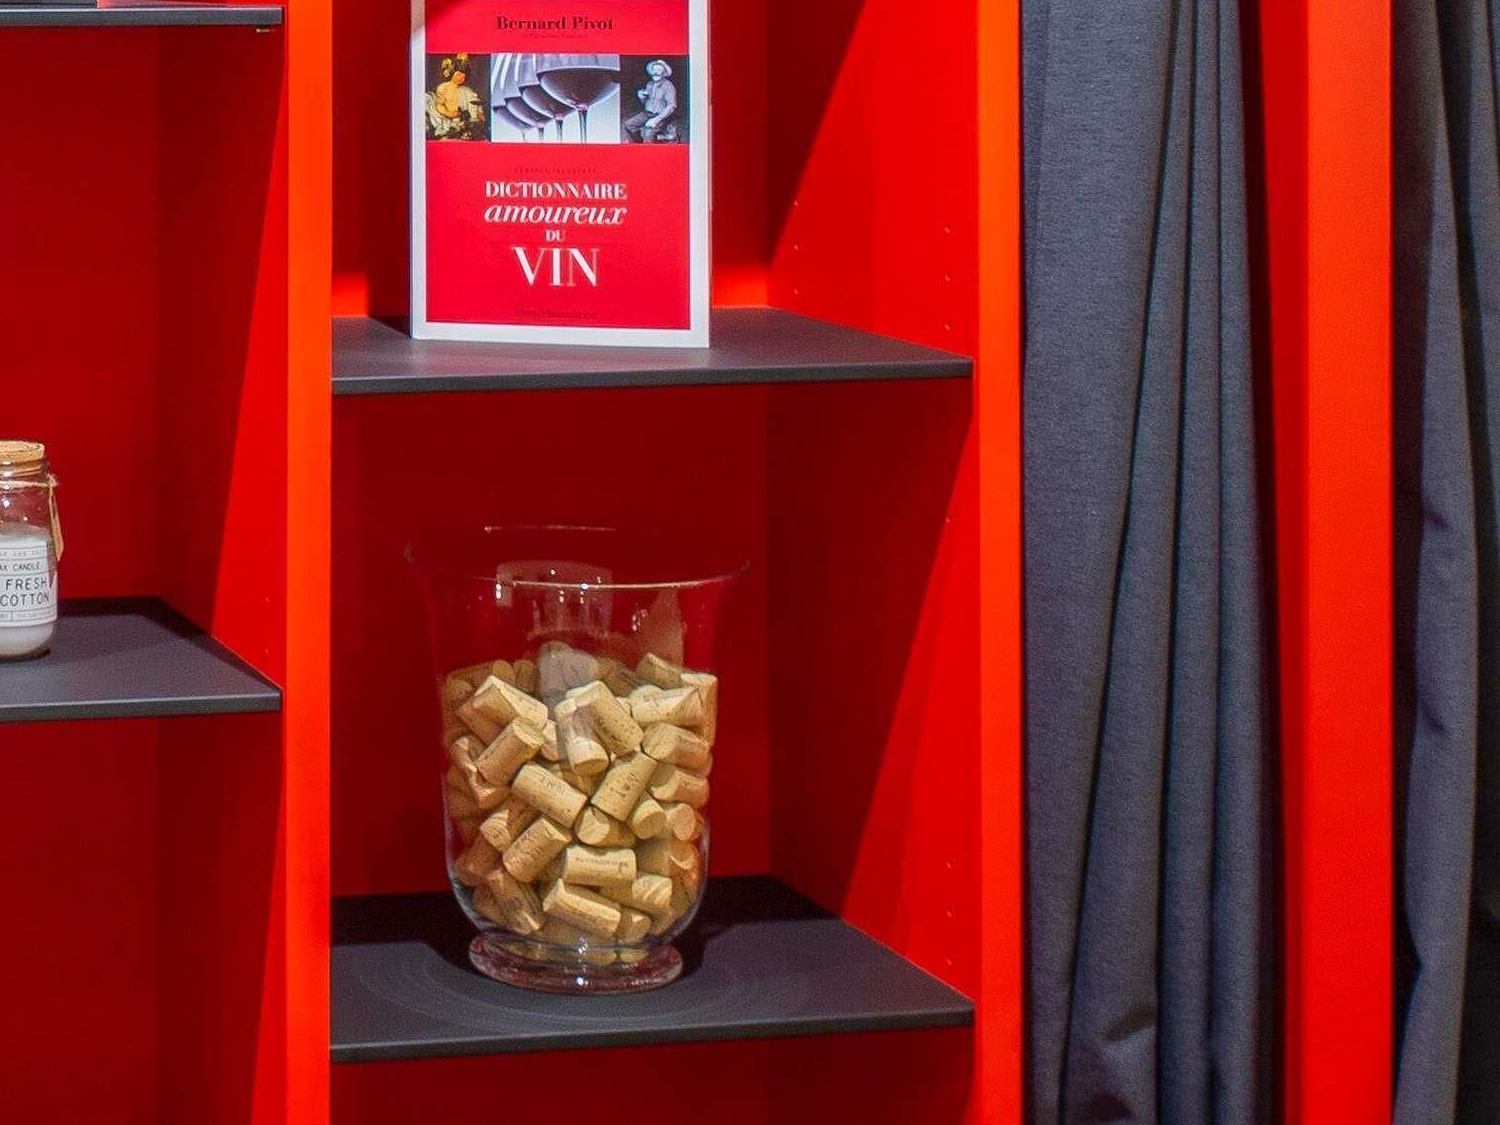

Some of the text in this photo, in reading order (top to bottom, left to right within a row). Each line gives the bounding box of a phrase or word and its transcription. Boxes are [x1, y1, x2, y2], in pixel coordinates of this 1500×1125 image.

[497, 15, 613, 30] Bernard Pivot
[484, 180, 628, 200] DICTIONNAIRE
[484, 204, 628, 226] amoureux
[545, 229, 566, 242] DU
[511, 246, 600, 287] VIN
[5, 577, 47, 591] FRESH
[0, 592, 50, 607] COTTON
